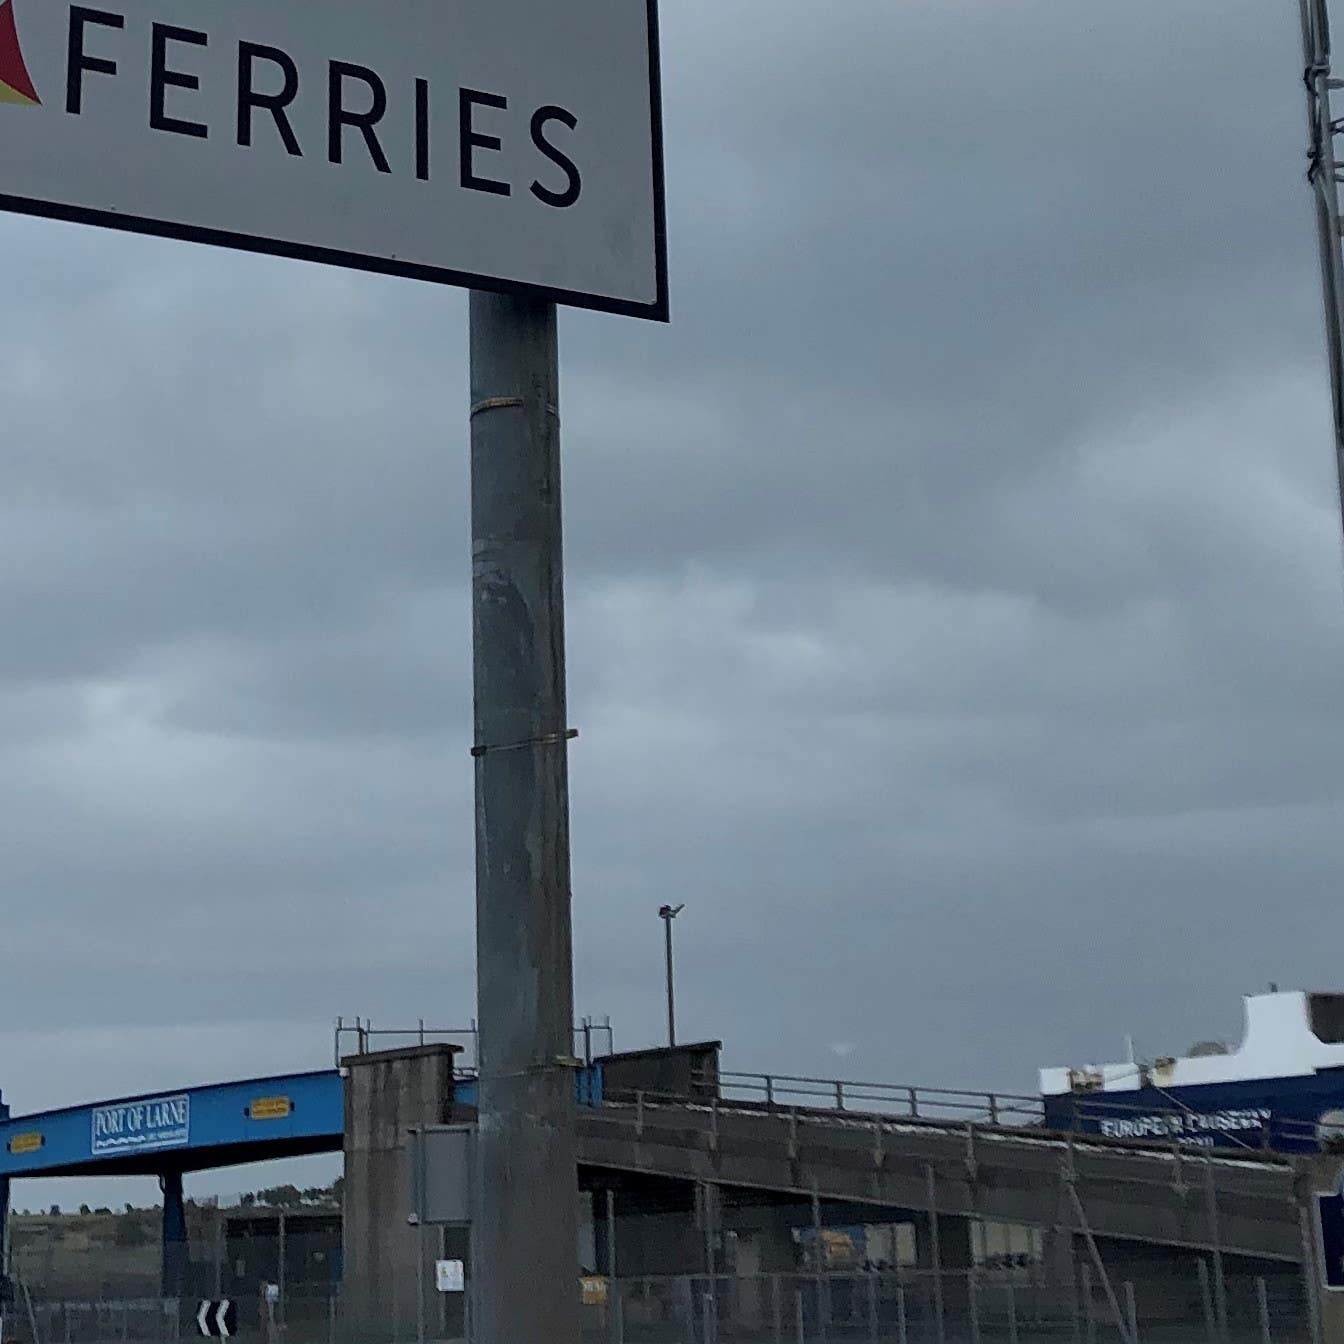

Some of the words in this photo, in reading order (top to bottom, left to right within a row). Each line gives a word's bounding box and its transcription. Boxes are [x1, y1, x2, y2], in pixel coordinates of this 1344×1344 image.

[65, 3, 582, 208] FERRIES
[96, 1109, 125, 1136] PORT
[127, 1106, 144, 1131] OF
[146, 1101, 186, 1128] LARNE
